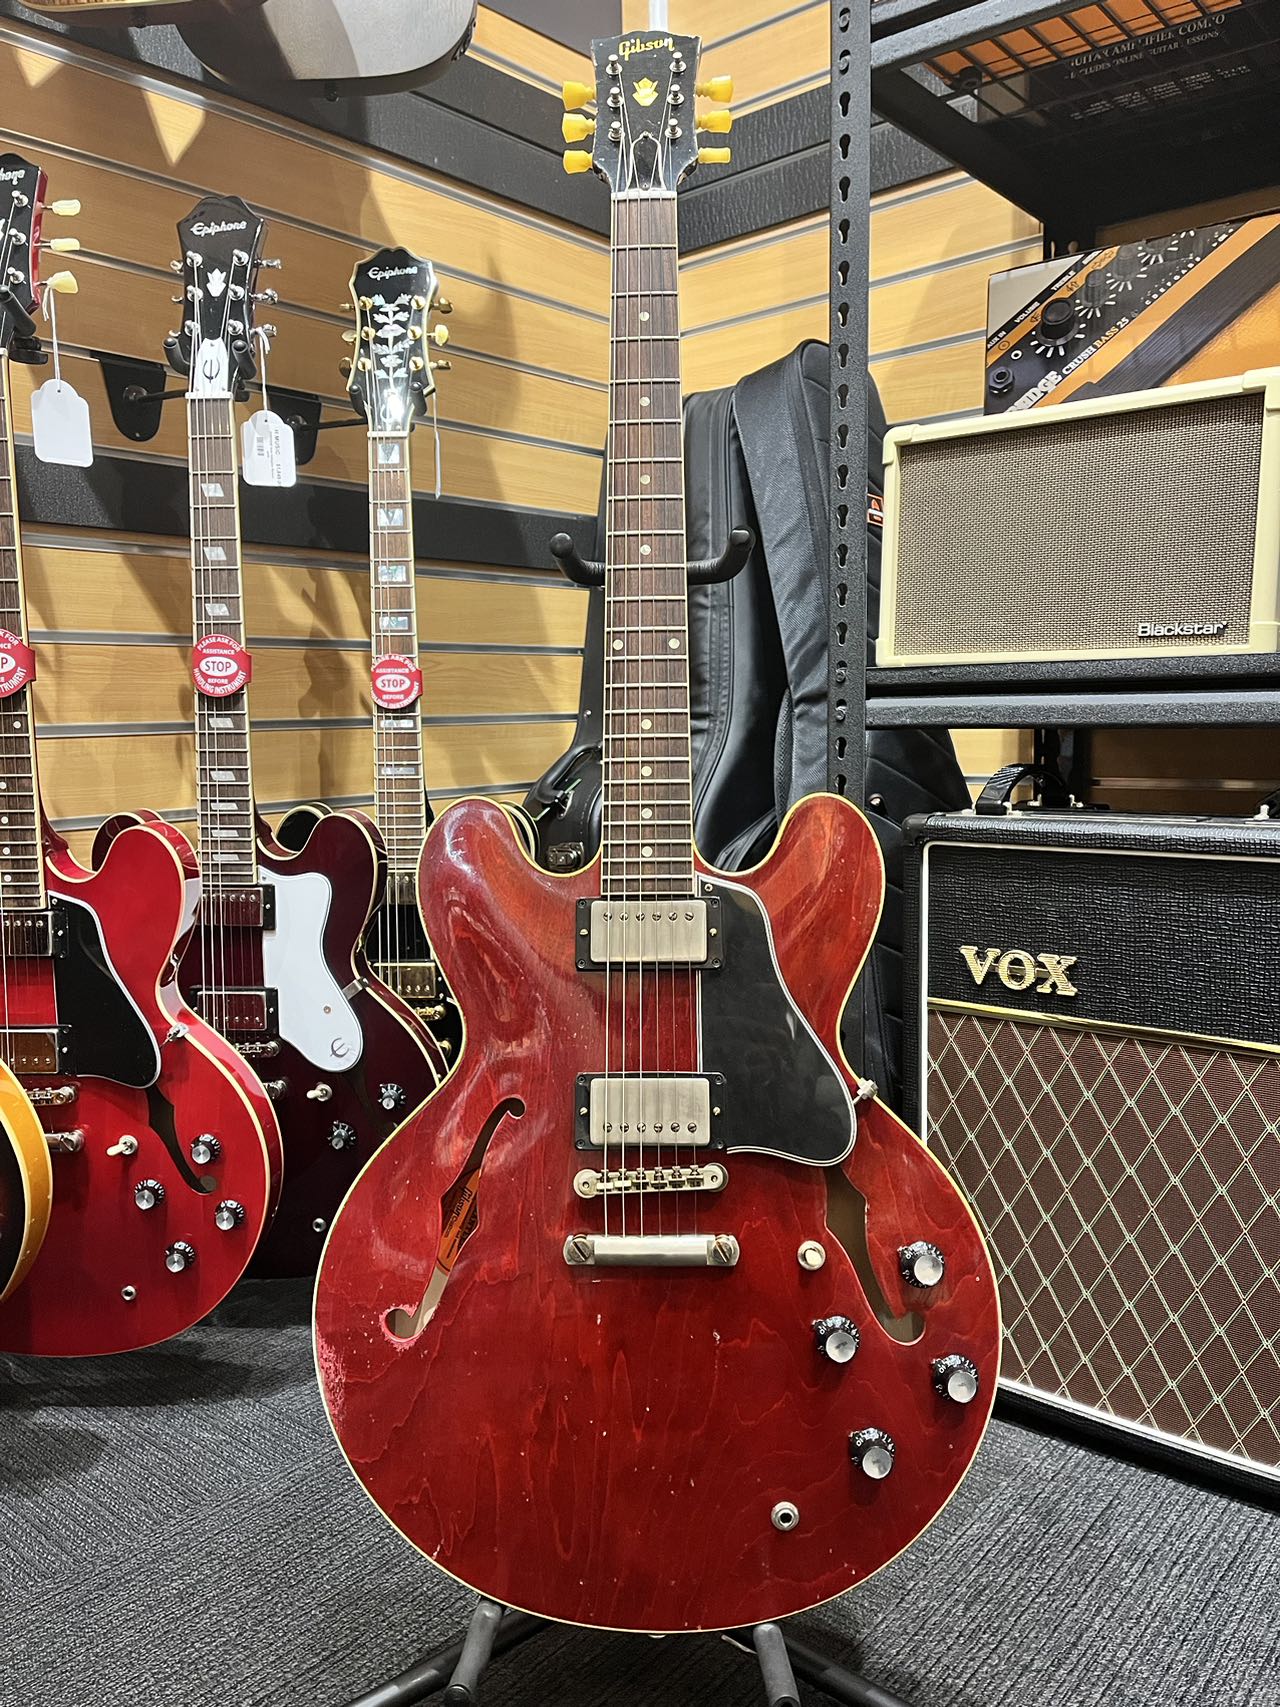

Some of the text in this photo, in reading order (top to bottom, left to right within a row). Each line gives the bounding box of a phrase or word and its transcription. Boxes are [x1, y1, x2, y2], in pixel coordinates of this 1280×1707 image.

[618, 36, 675, 61] Gibson
[1069, 14, 1225, 67] UITA AMIFIE COMO
[190, 221, 248, 237] Epiphone
[367, 266, 418, 281] Epiphone
[1061, 345, 1094, 375] CRUSH
[1092, 326, 1119, 350] BASS
[1116, 317, 1130, 330] 25
[1137, 621, 1227, 638] Blackstar
[4, 633, 19, 646] FOR
[197, 637, 216, 651] PLEASE
[229, 640, 241, 653] FOR
[204, 660, 232, 673] STOP
[193, 668, 247, 695] HANDLING INSTRUMENT
[381, 678, 406, 689] STOP
[959, 945, 1079, 997] VOX
